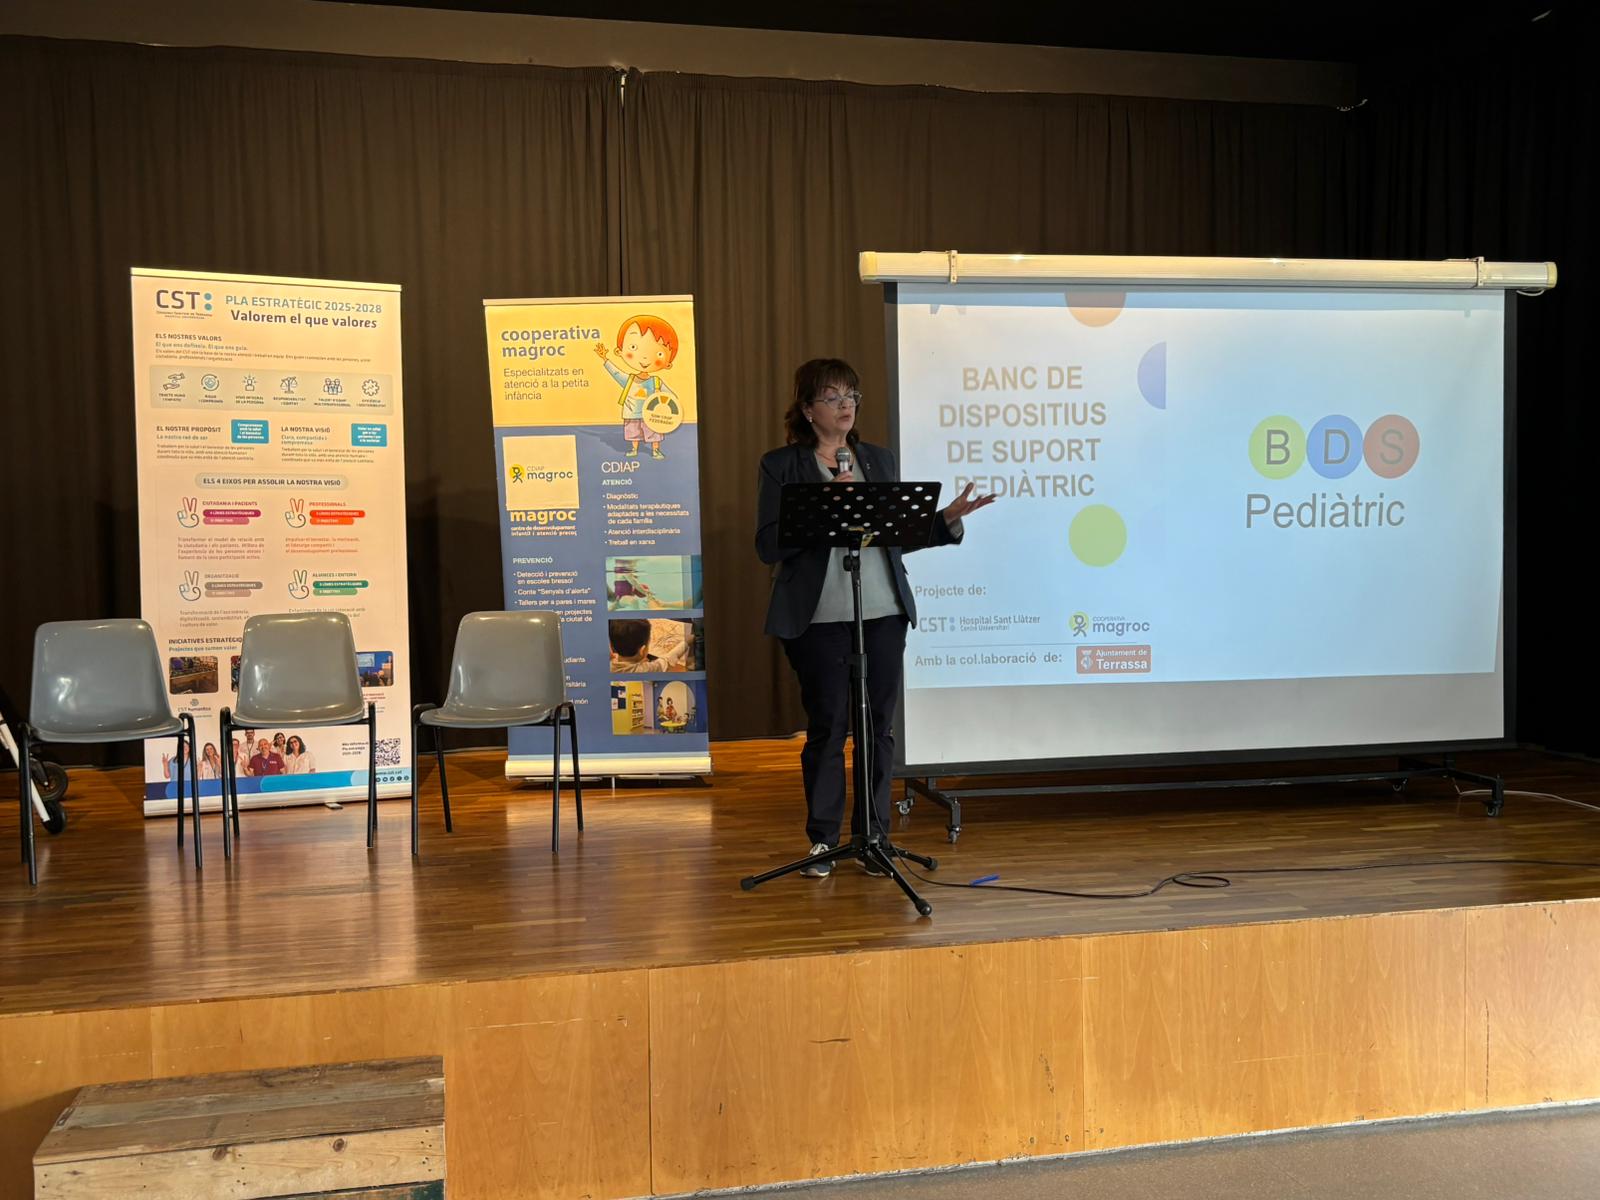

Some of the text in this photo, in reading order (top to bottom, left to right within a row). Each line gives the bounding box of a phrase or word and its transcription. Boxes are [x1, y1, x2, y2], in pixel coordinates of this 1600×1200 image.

[226, 296, 248, 306] PLA
[324, 302, 382, 314] 2025-2028
[230, 310, 377, 328] Valorem el que valores
[501, 326, 600, 344] cooperativa
[502, 345, 566, 360] magroc
[503, 367, 569, 378] Especialitzats
[962, 366, 1083, 391] BANC DE
[504, 379, 539, 388] atenció
[550, 379, 559, 387] la
[562, 379, 589, 389] petita
[505, 391, 542, 400] infància
[939, 402, 1106, 428] DISPOSITIUS
[947, 438, 1100, 464] DE SUPORT
[601, 461, 640, 473] CDIAP
[527, 471, 573, 482] magroc
[955, 470, 1095, 497] PEDIÀTRIC
[511, 510, 576, 525] magroc
[1246, 492, 1405, 528] Pediàtric
[915, 584, 986, 599] Projecte de:
[959, 615, 992, 625] Hospital
[993, 615, 1011, 624] Sant
[1013, 614, 1040, 624] Llàtzer
[1093, 622, 1150, 636] magroc
[915, 652, 1062, 667] Amb la col.laboració de:
[1096, 649, 1136, 658] Ajuntament
[1096, 657, 1148, 670] Terrassa
